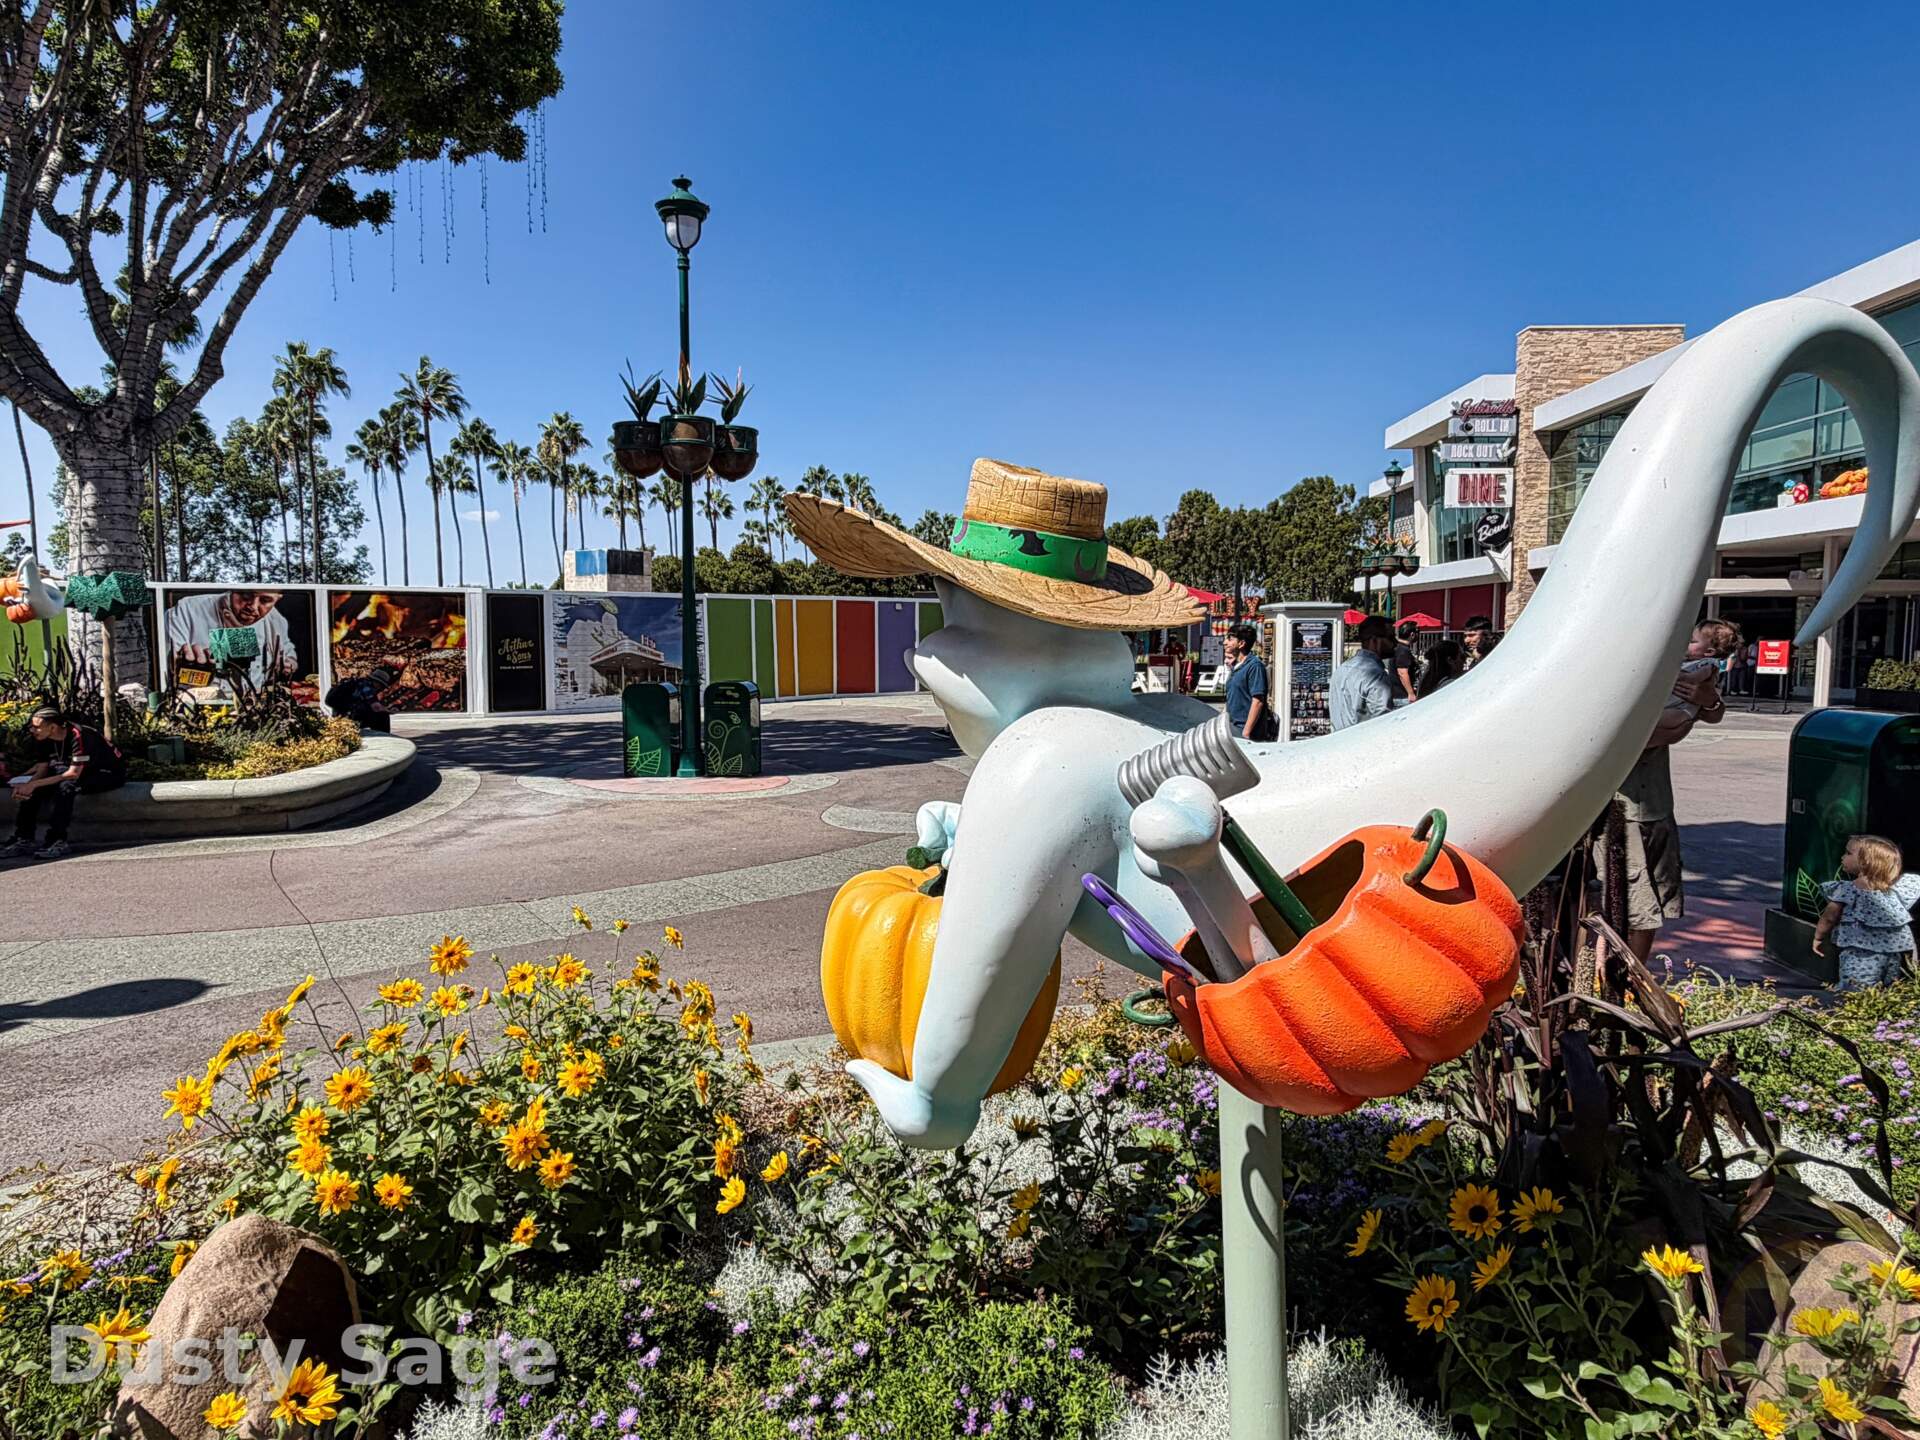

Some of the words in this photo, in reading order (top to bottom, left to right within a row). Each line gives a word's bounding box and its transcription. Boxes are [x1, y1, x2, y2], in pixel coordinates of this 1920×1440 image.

[1474, 419, 1498, 433] ROLL
[1499, 419, 1510, 433] IN
[1451, 444, 1474, 458] ROCK
[1475, 444, 1494, 458] OUT
[1458, 473, 1506, 505] DINE
[1477, 511, 1509, 542] Bowl
[511, 651, 531, 664] Sons
